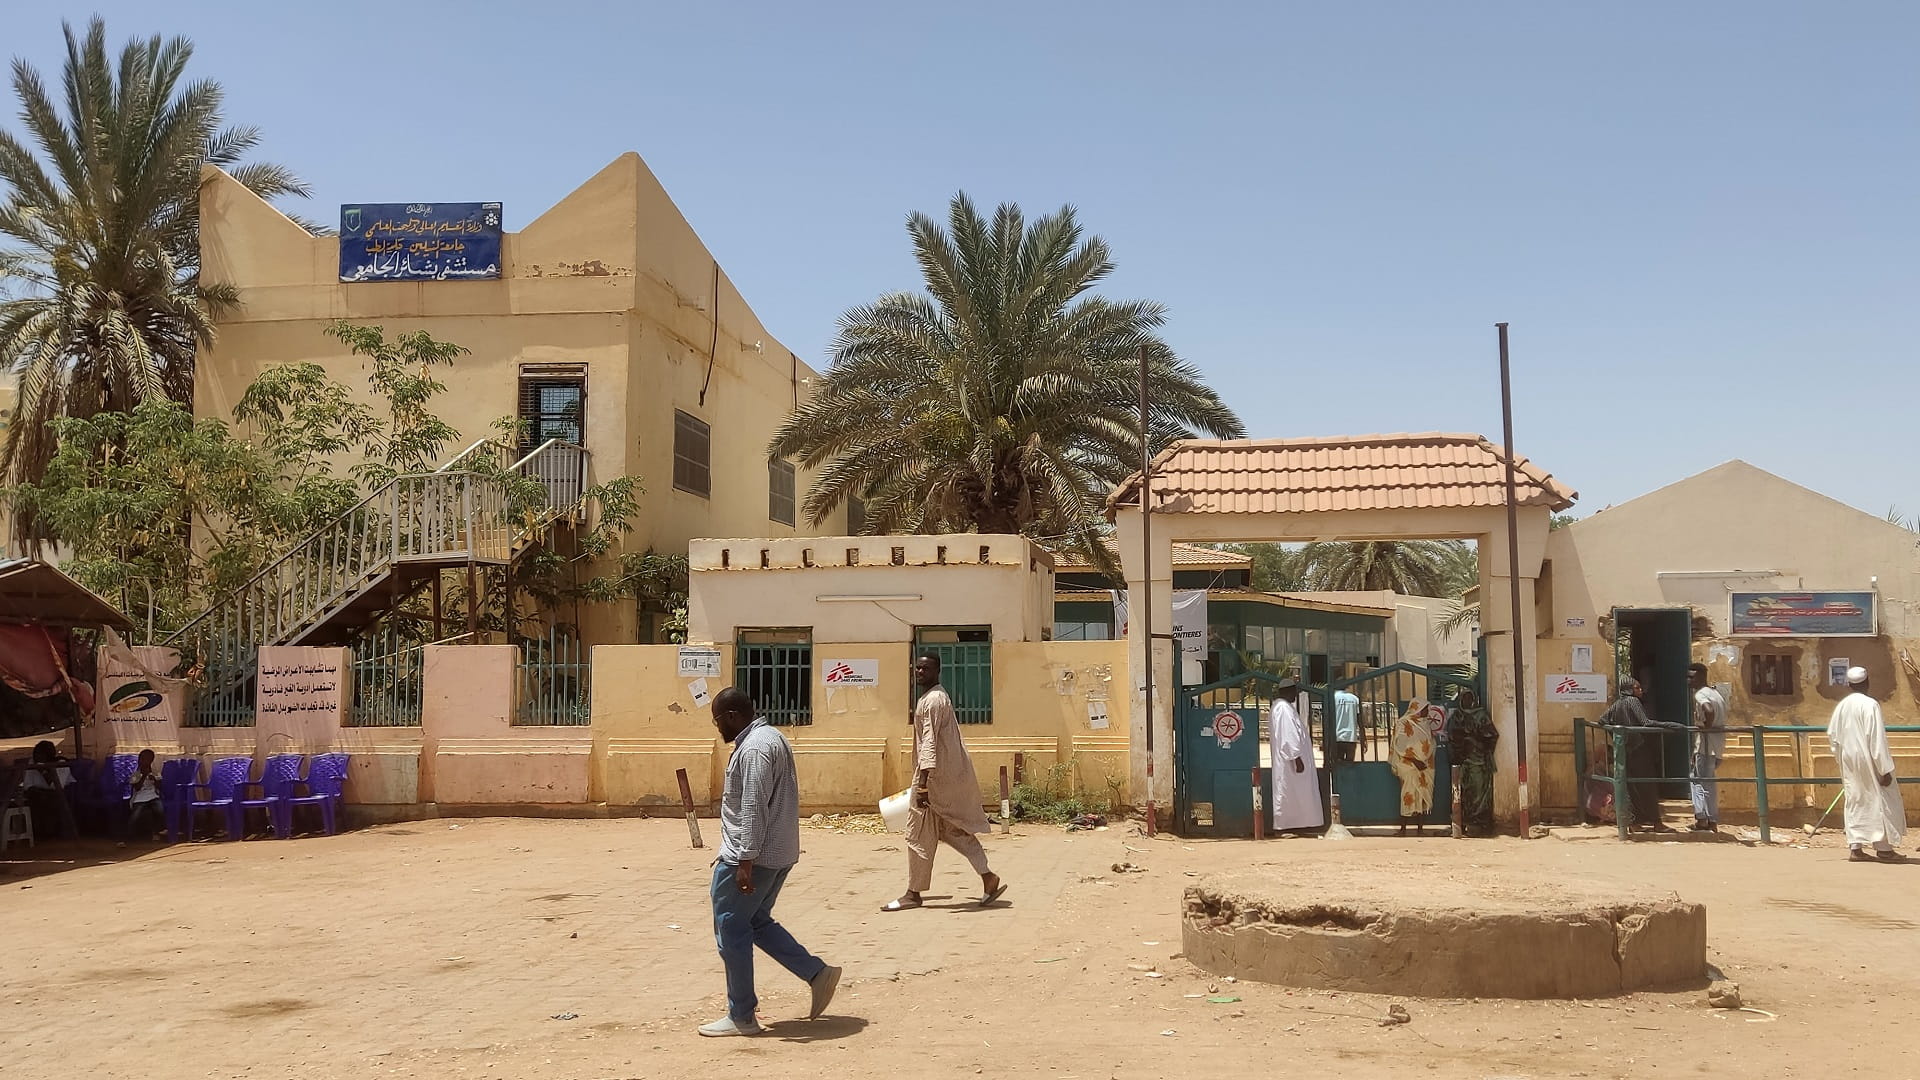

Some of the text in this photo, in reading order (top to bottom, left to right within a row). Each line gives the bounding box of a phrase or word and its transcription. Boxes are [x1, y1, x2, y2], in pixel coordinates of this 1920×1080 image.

[440, 239, 465, 254] جامعة
[394, 253, 438, 279] بشائر
[1172, 631, 1202, 639] ONTIERES
